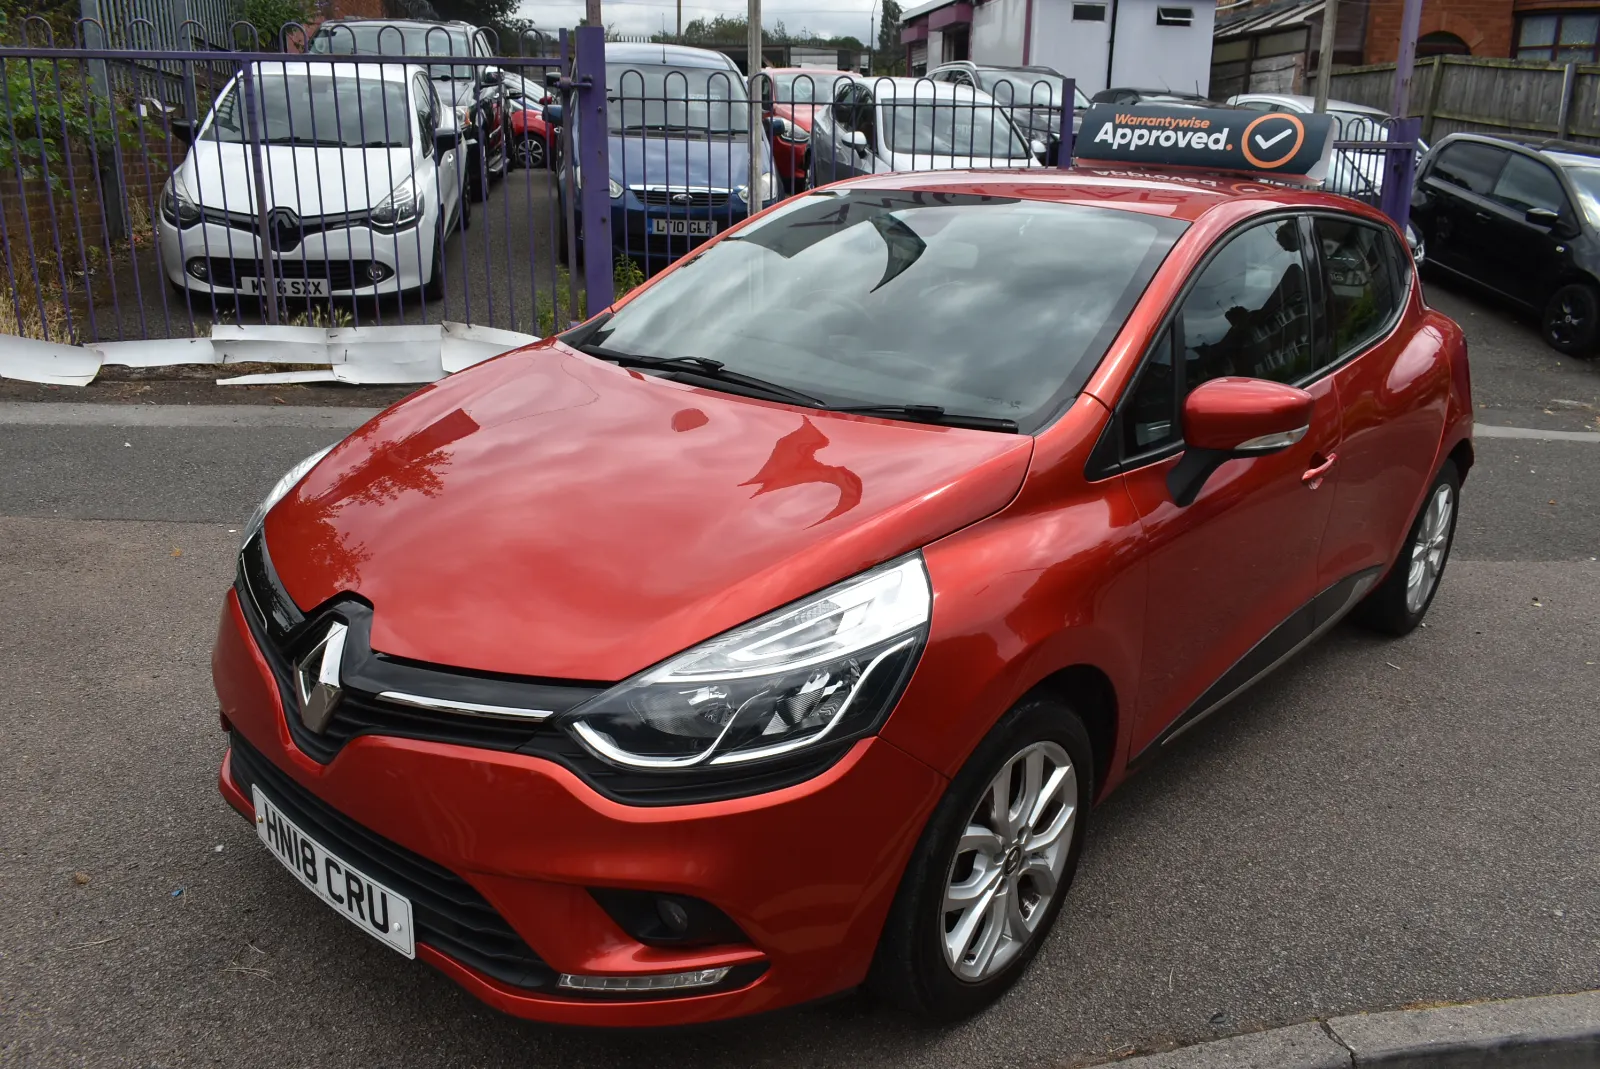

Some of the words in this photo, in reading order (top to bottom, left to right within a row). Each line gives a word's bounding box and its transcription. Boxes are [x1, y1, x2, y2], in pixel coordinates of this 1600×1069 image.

[1114, 113, 1211, 129] Warrantywise
[1093, 121, 1233, 151] Approved.
[251, 279, 287, 295] MV6
[291, 281, 323, 296] SXX
[264, 802, 318, 885] HN18
[324, 857, 390, 935] CRU
